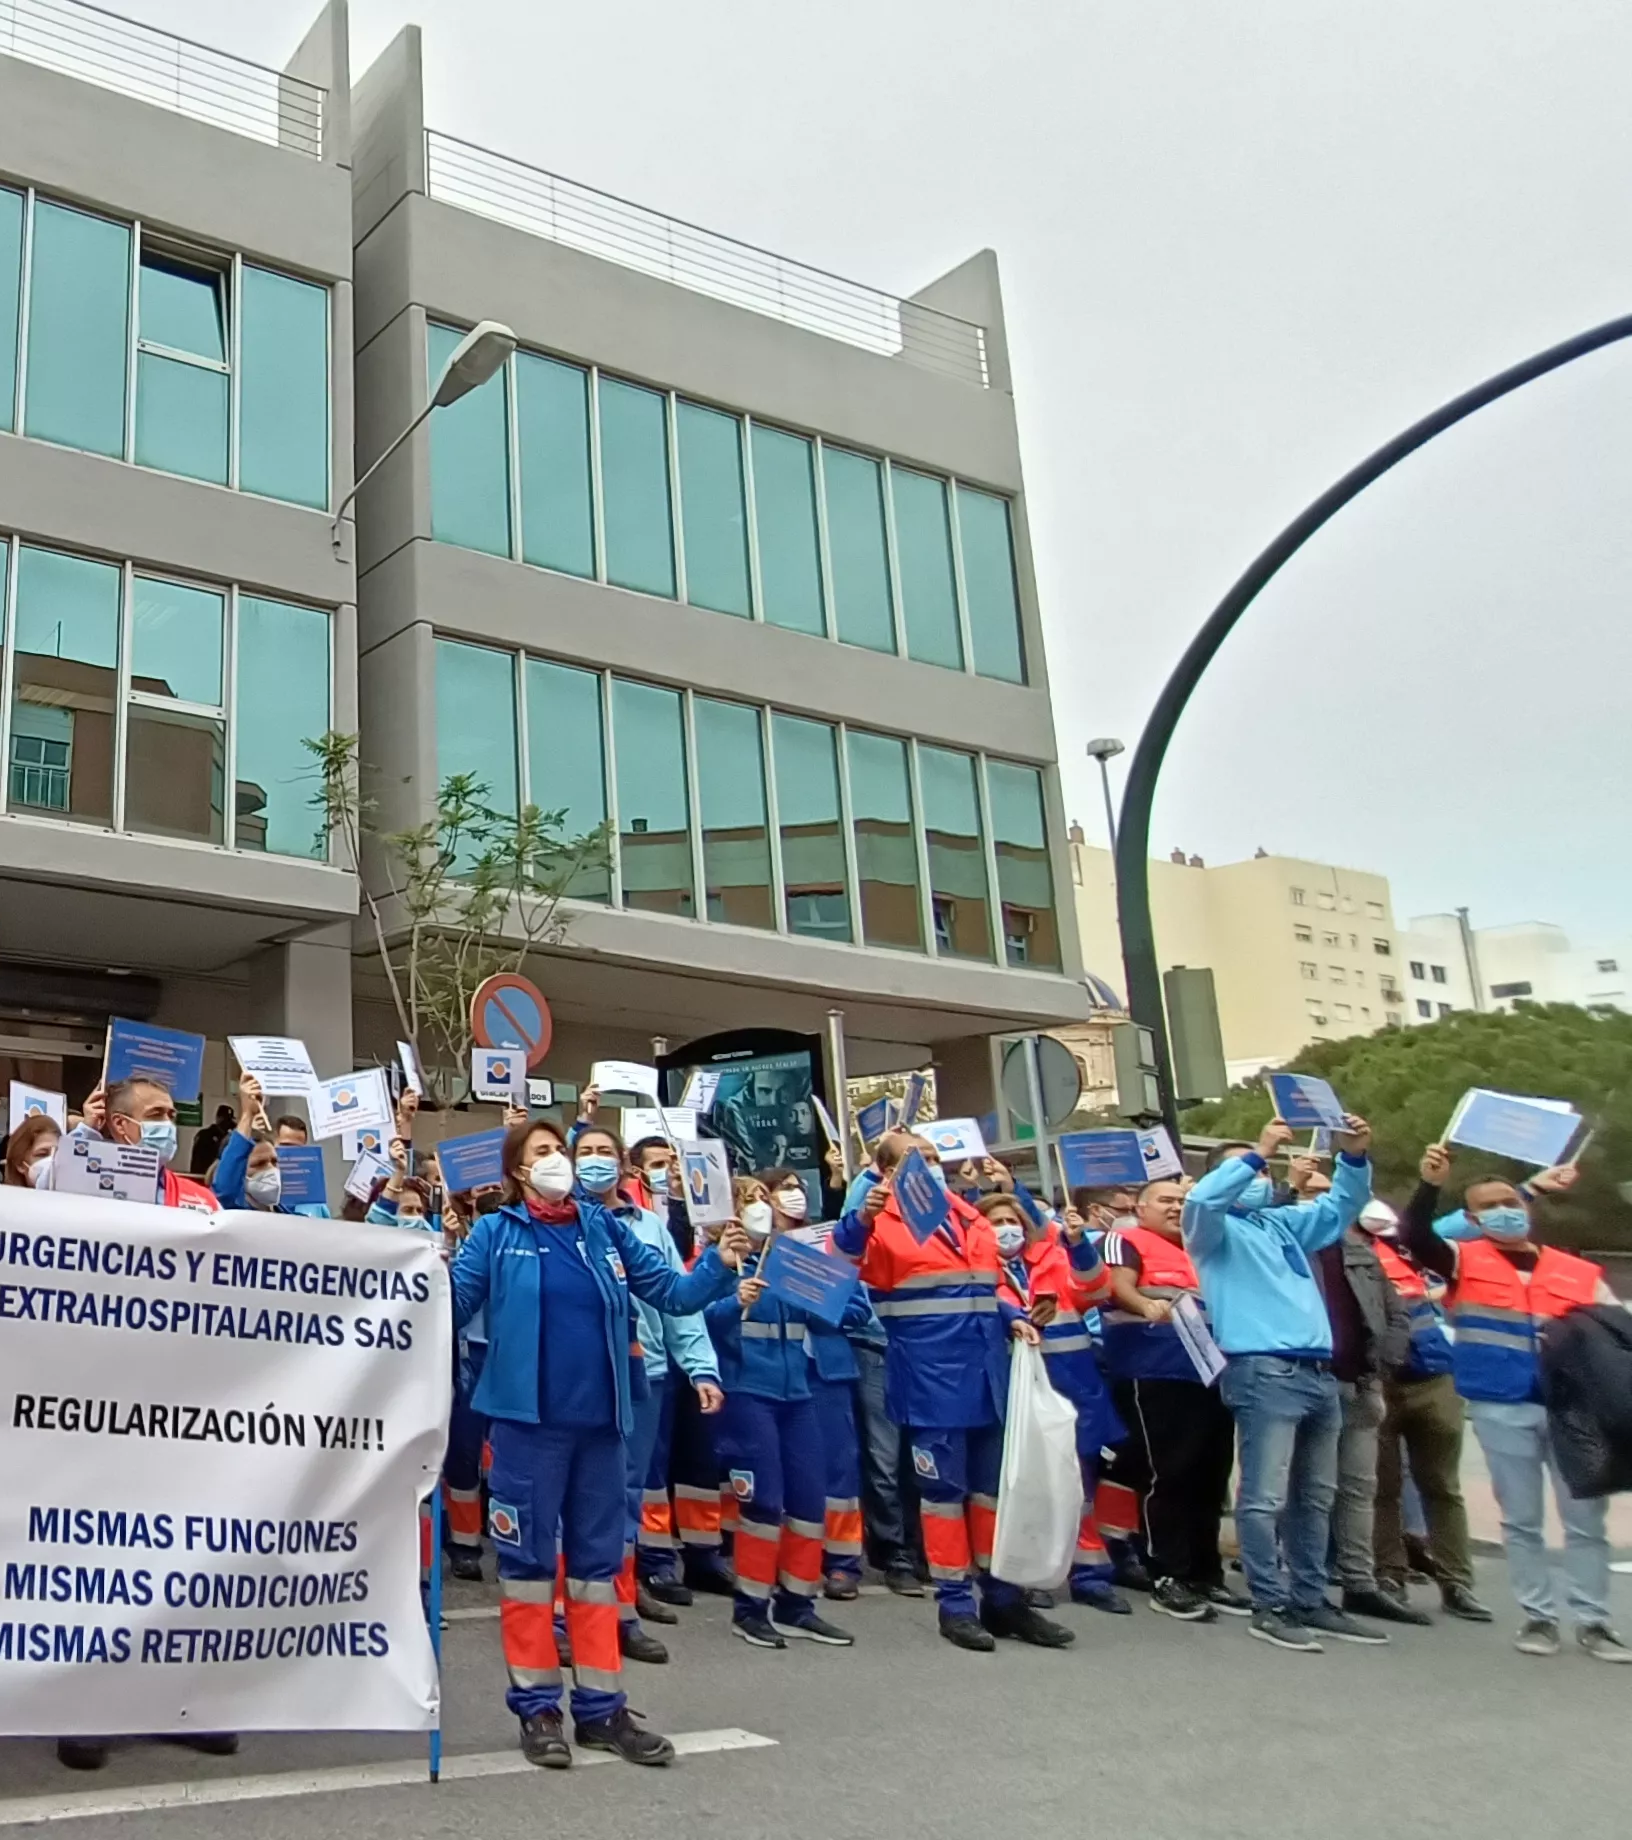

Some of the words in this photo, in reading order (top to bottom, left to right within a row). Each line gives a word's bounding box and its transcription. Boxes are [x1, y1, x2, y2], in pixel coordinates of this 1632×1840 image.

[185, 1250, 206, 1283] Y
[211, 1252, 430, 1304] EMERGENCIAS
[354, 1317, 413, 1351] SAS
[12, 1393, 306, 1448] REGULARIZACIÓN
[312, 1414, 385, 1451] YA!!!
[28, 1505, 175, 1550] MISMAS
[184, 1515, 358, 1555] FUNCIONES
[4, 1562, 154, 1607] MISMAS
[163, 1568, 369, 1609] CONDICIONES
[140, 1621, 390, 1664] RETRIBUCIONES
